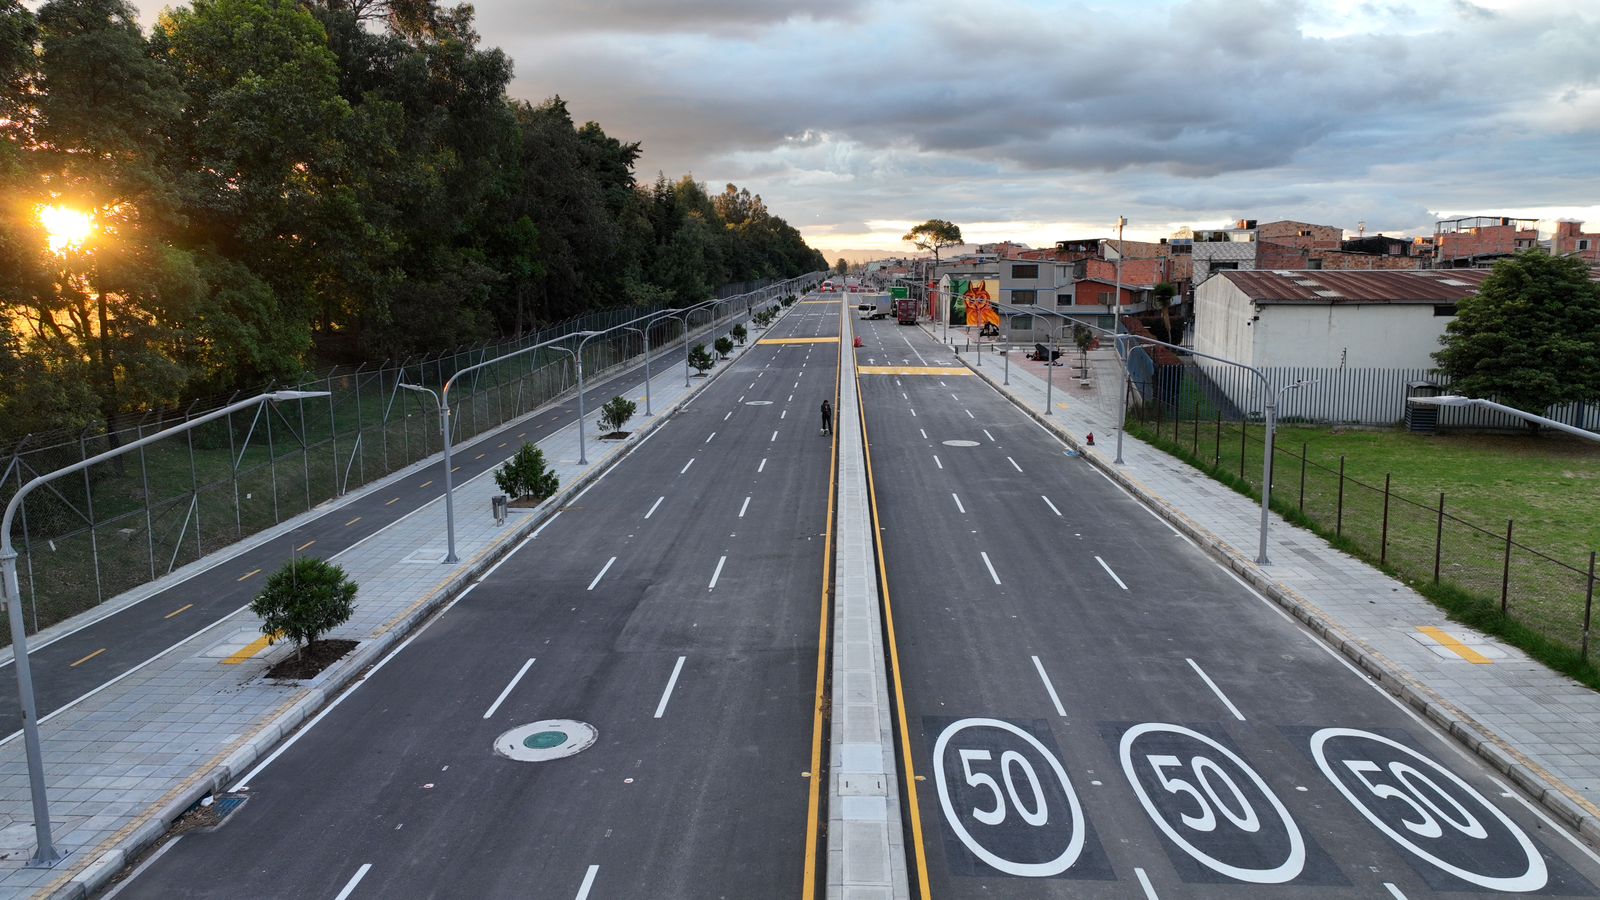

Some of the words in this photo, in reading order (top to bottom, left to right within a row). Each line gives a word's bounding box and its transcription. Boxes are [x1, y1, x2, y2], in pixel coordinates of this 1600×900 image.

[959, 749, 1048, 826] 50
[1146, 755, 1260, 832] 50
[1342, 760, 1488, 839] 50
